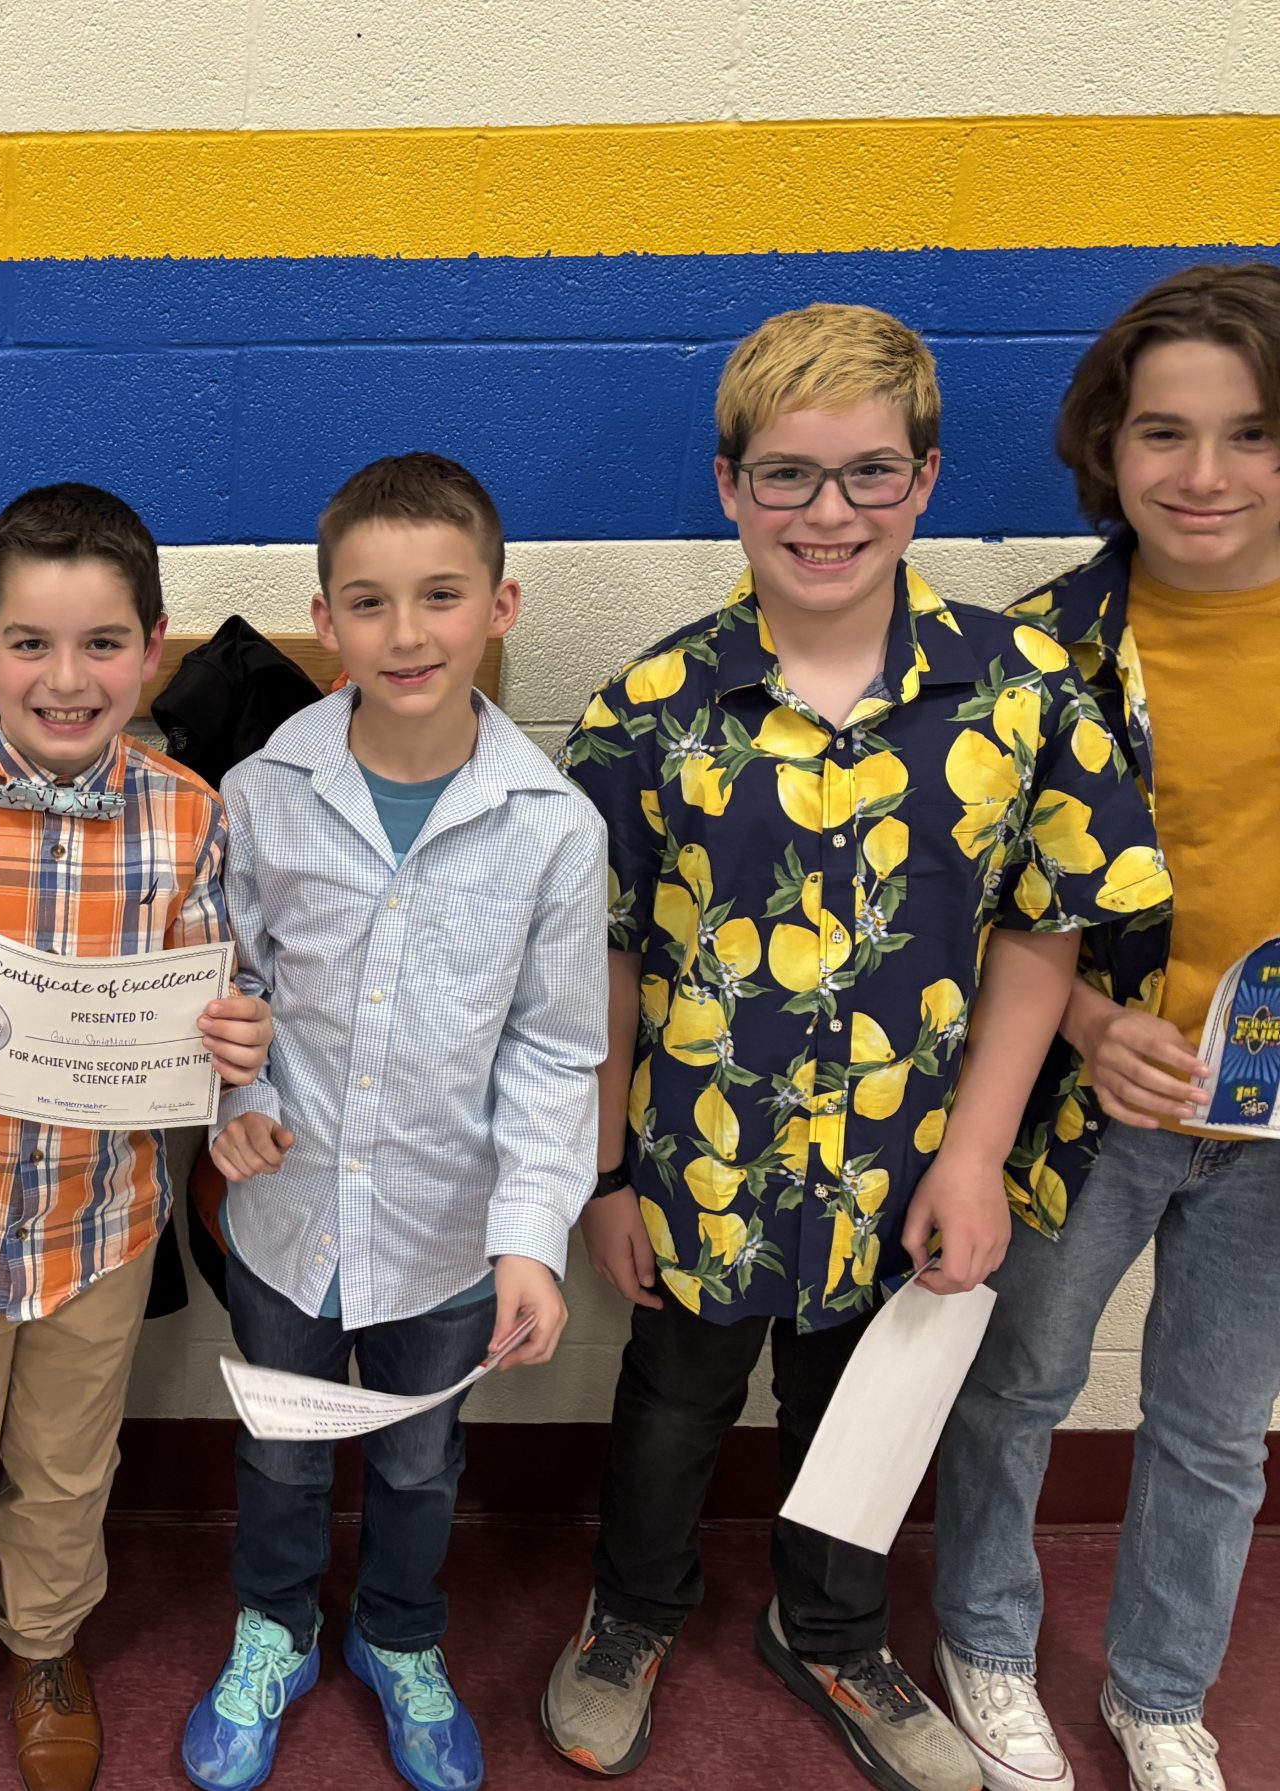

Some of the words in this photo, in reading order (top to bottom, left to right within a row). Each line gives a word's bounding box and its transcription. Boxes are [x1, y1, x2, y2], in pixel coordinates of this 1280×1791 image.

[97, 979, 120, 999] of
[121, 968, 219, 993] Excellence
[70, 1011, 136, 1024] PRESENTED
[139, 1010, 159, 1022] TO:
[1235, 1028, 1280, 1041] FAIR
[9, 1049, 29, 1062] FOR
[31, 1054, 94, 1071] ACHIEVING
[96, 1061, 139, 1072] SECOND
[140, 1057, 174, 1070] PLACE
[175, 1055, 190, 1067] IN
[192, 1052, 212, 1064] THE
[72, 1073, 120, 1085] SCIENCE
[121, 1074, 147, 1085] FAIR
[1235, 1086, 1258, 1102] 1st
